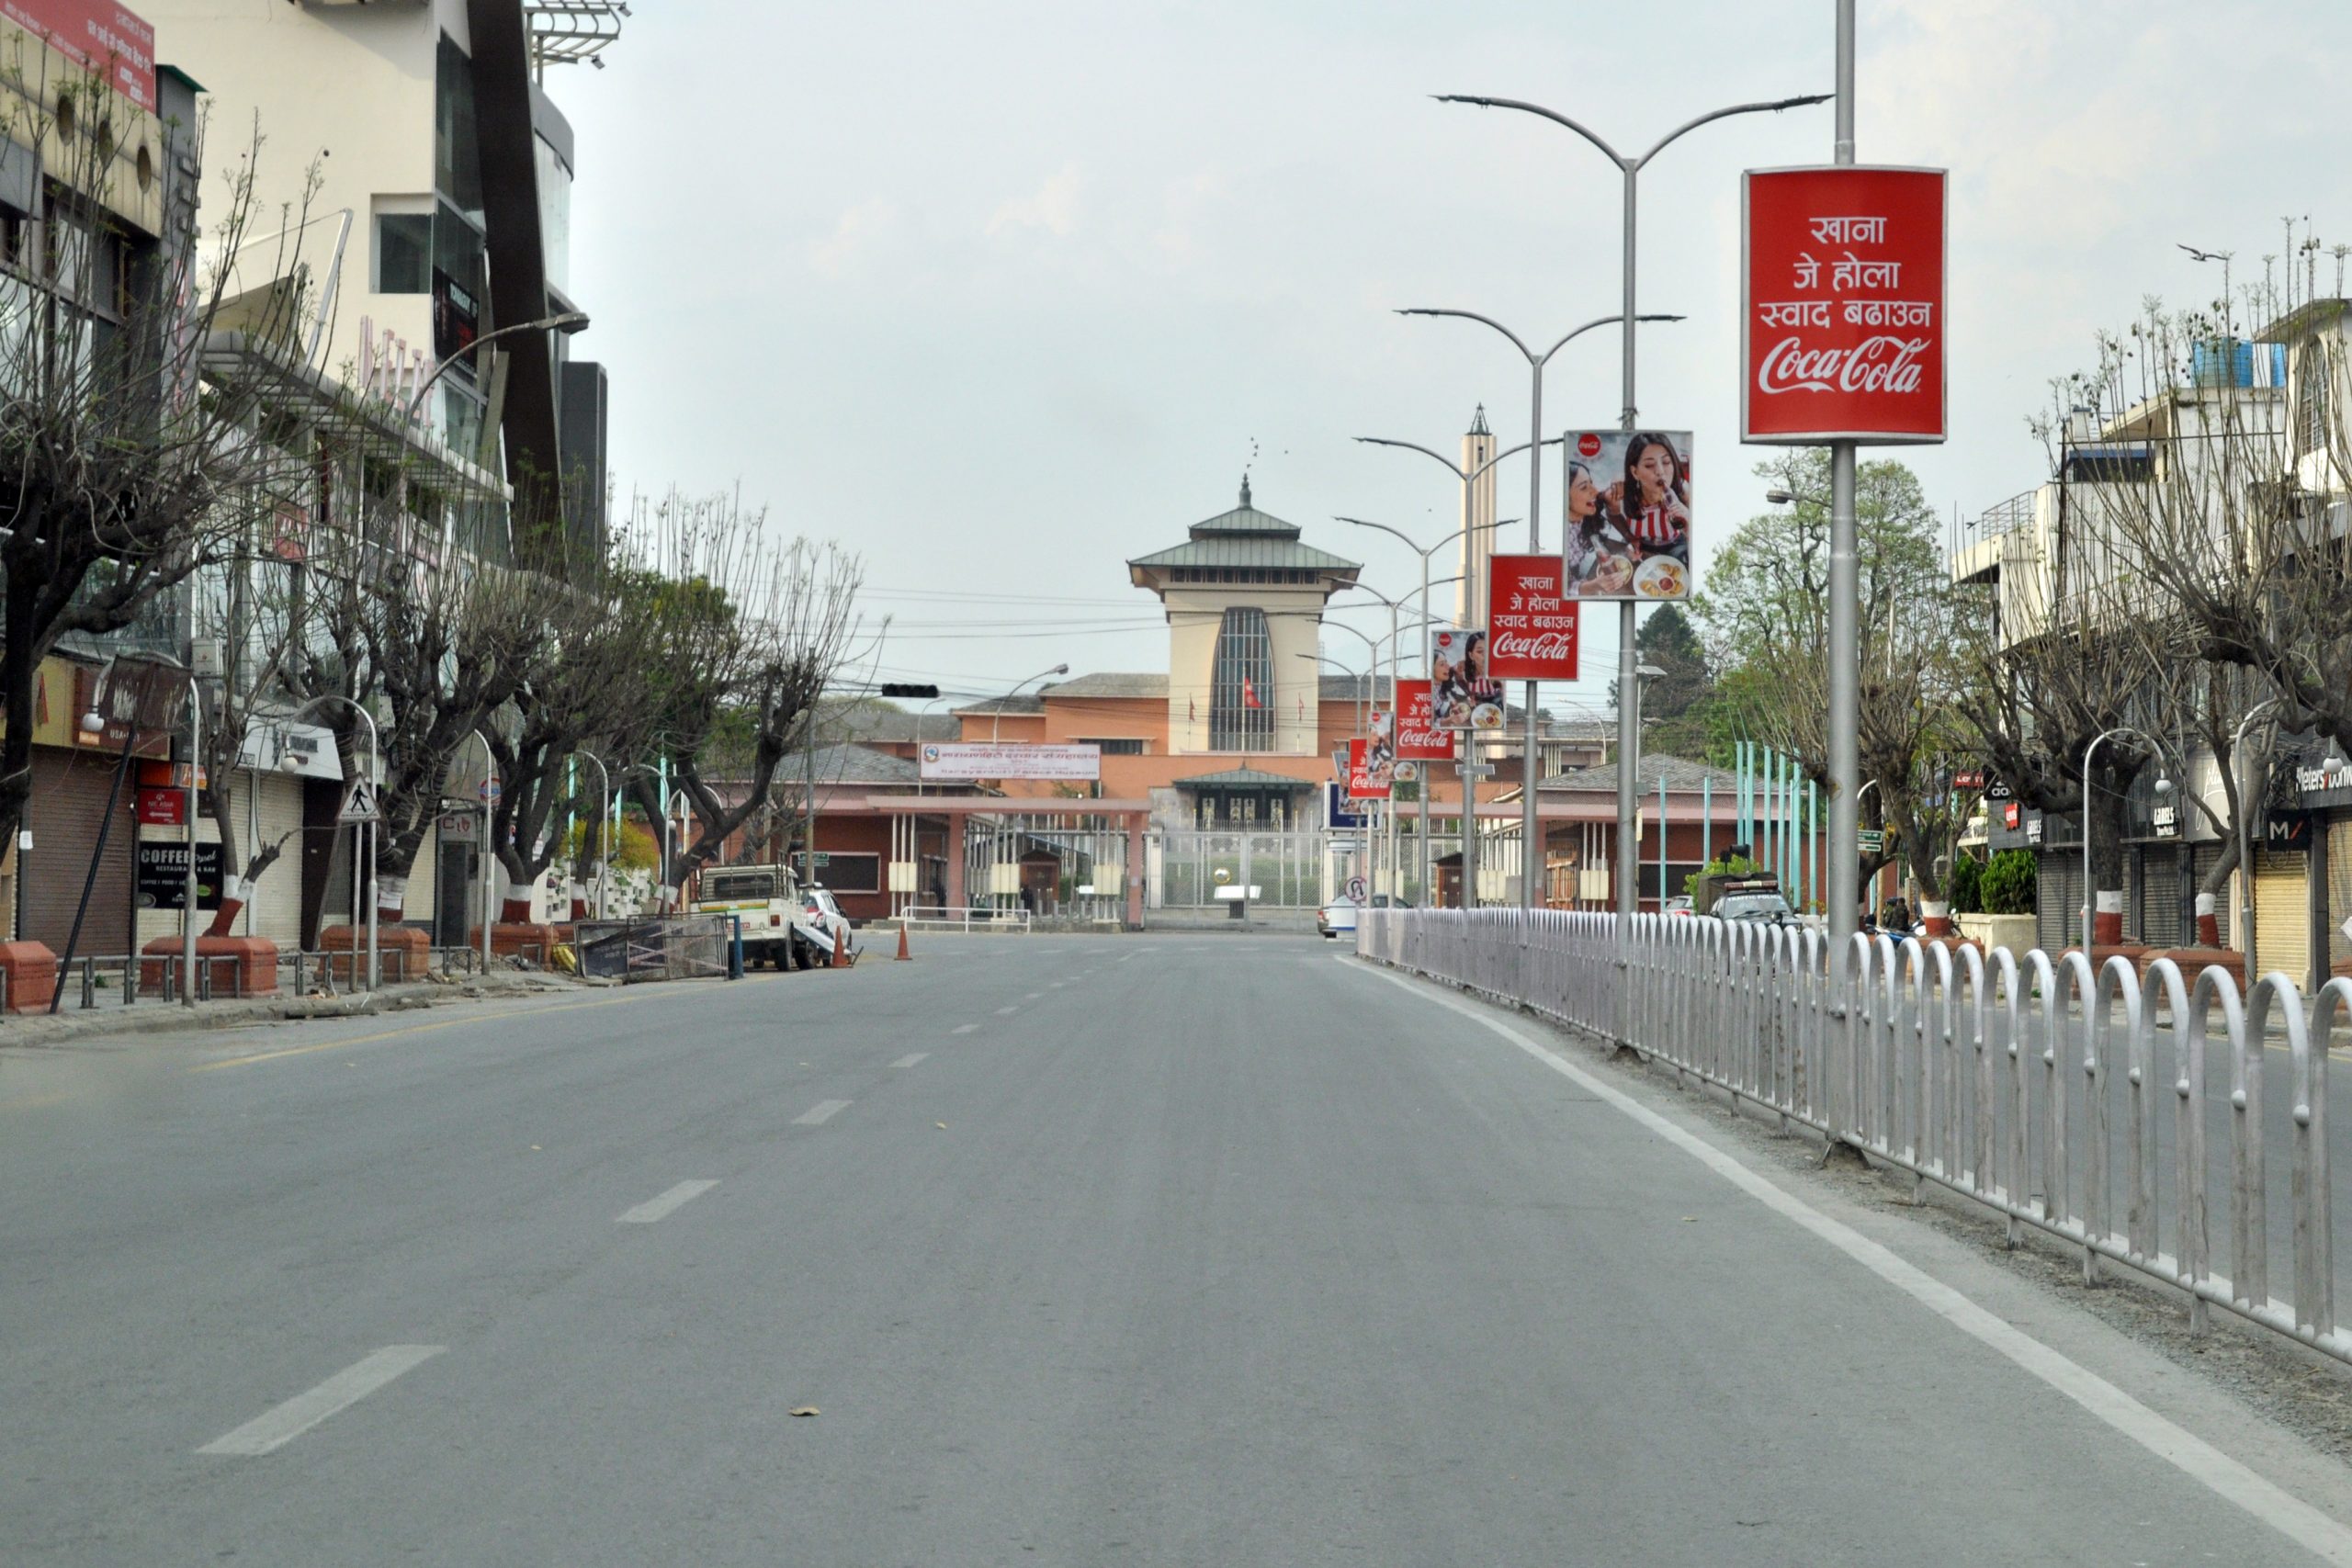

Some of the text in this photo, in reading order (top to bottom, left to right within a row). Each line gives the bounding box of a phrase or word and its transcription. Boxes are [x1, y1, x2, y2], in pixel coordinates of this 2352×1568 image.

[1809, 216, 1887, 244] खाना
[1793, 251, 1901, 292] जे होला
[1758, 299, 1933, 328] स्वाद बढाउन
[1758, 335, 1932, 394] Coca-Cola
[1518, 576, 1554, 591] खाना
[1510, 592, 1560, 612] जे होला
[1494, 615, 1574, 629] स्वाद बढाउन
[1493, 632, 1573, 660] Coca-Cola
[1399, 717, 1421, 728] स्वाद
